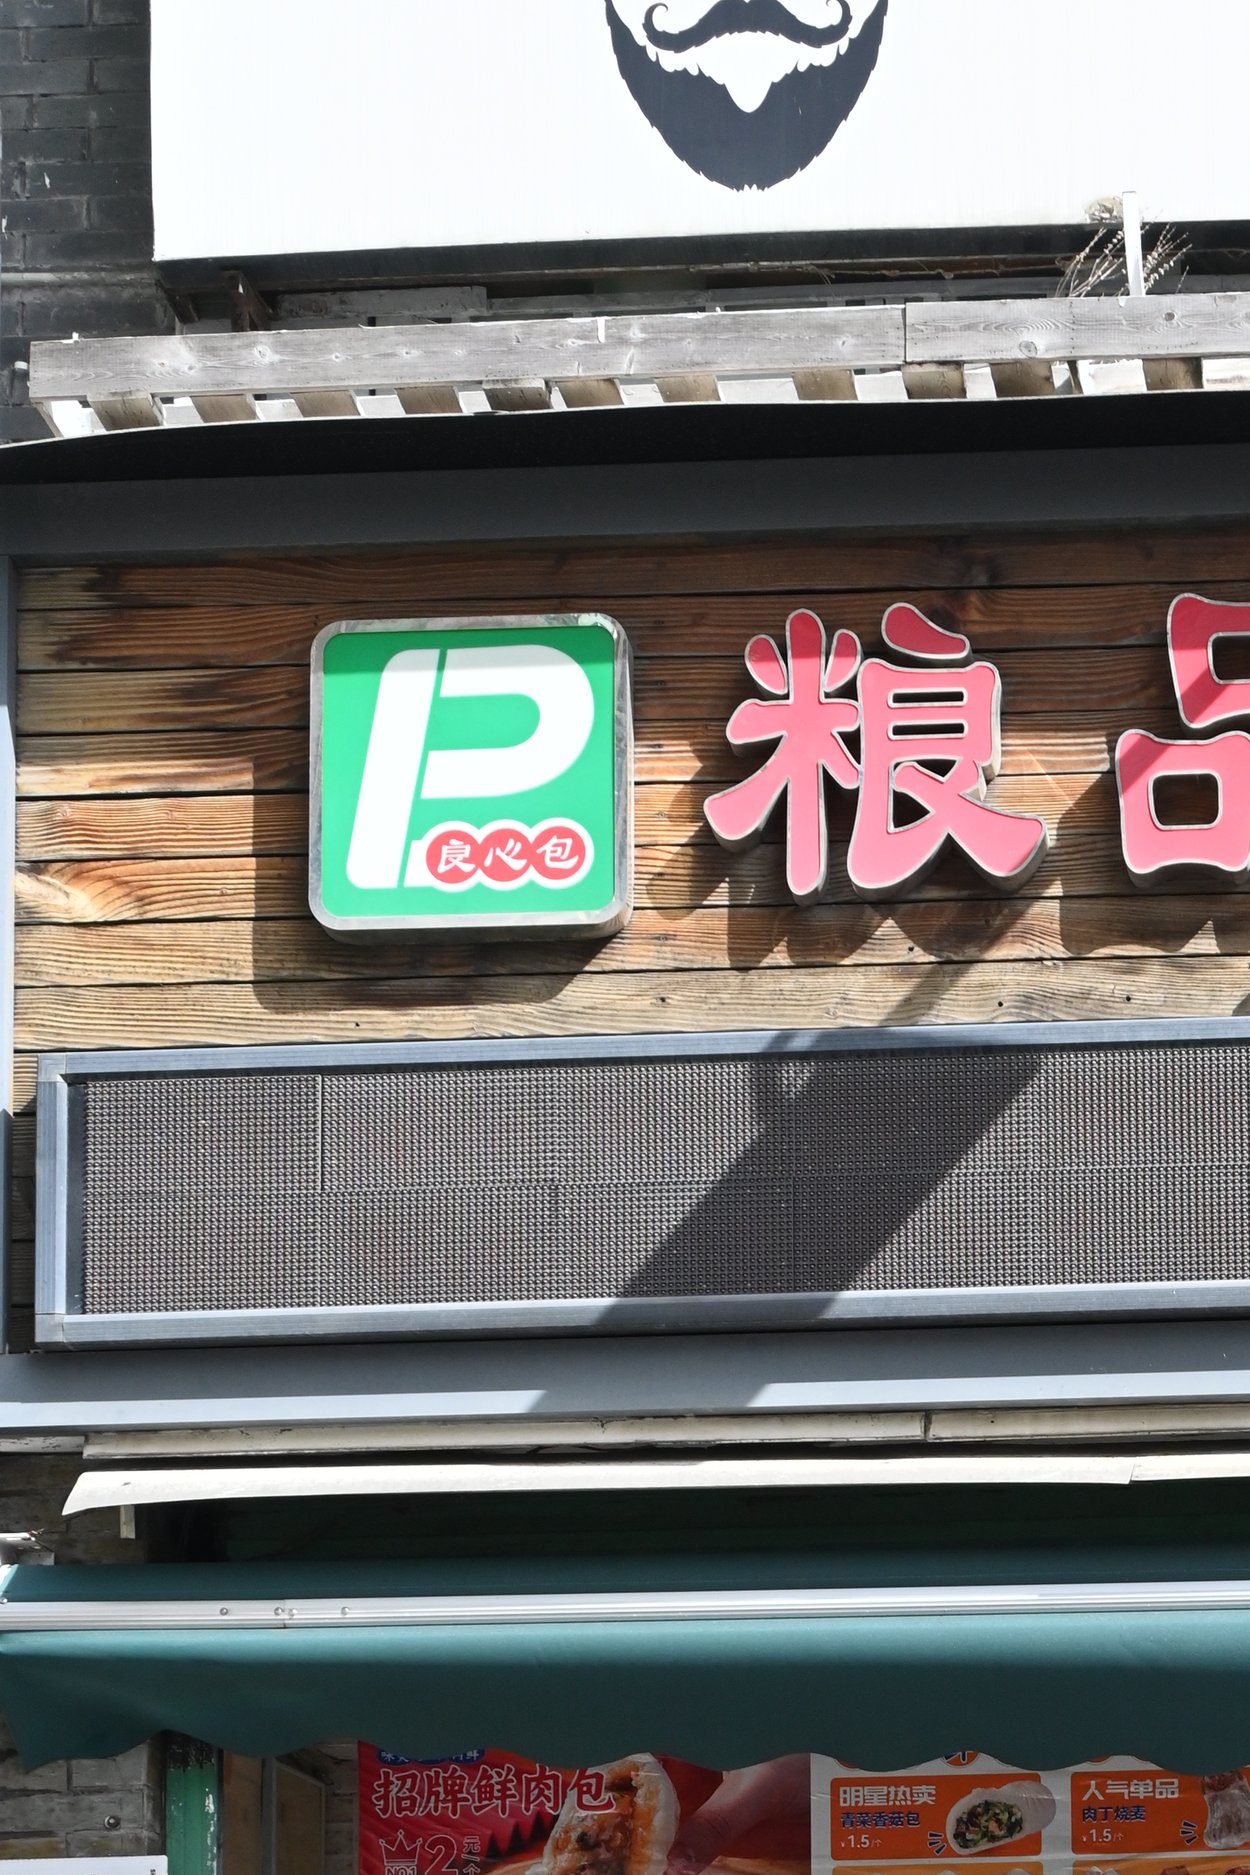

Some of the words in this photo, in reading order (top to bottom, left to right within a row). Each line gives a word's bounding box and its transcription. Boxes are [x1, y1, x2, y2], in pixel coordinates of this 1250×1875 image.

[434, 835, 580, 875] 良心包
[371, 1763, 617, 1820] 招牌鲜肉包
[839, 1785, 937, 1807] 明星热卖
[1081, 1778, 1180, 1801] 人气单品
[841, 1811, 921, 1829] 青菜香菇包
[1081, 1805, 1147, 1823] 肉丁烧麦
